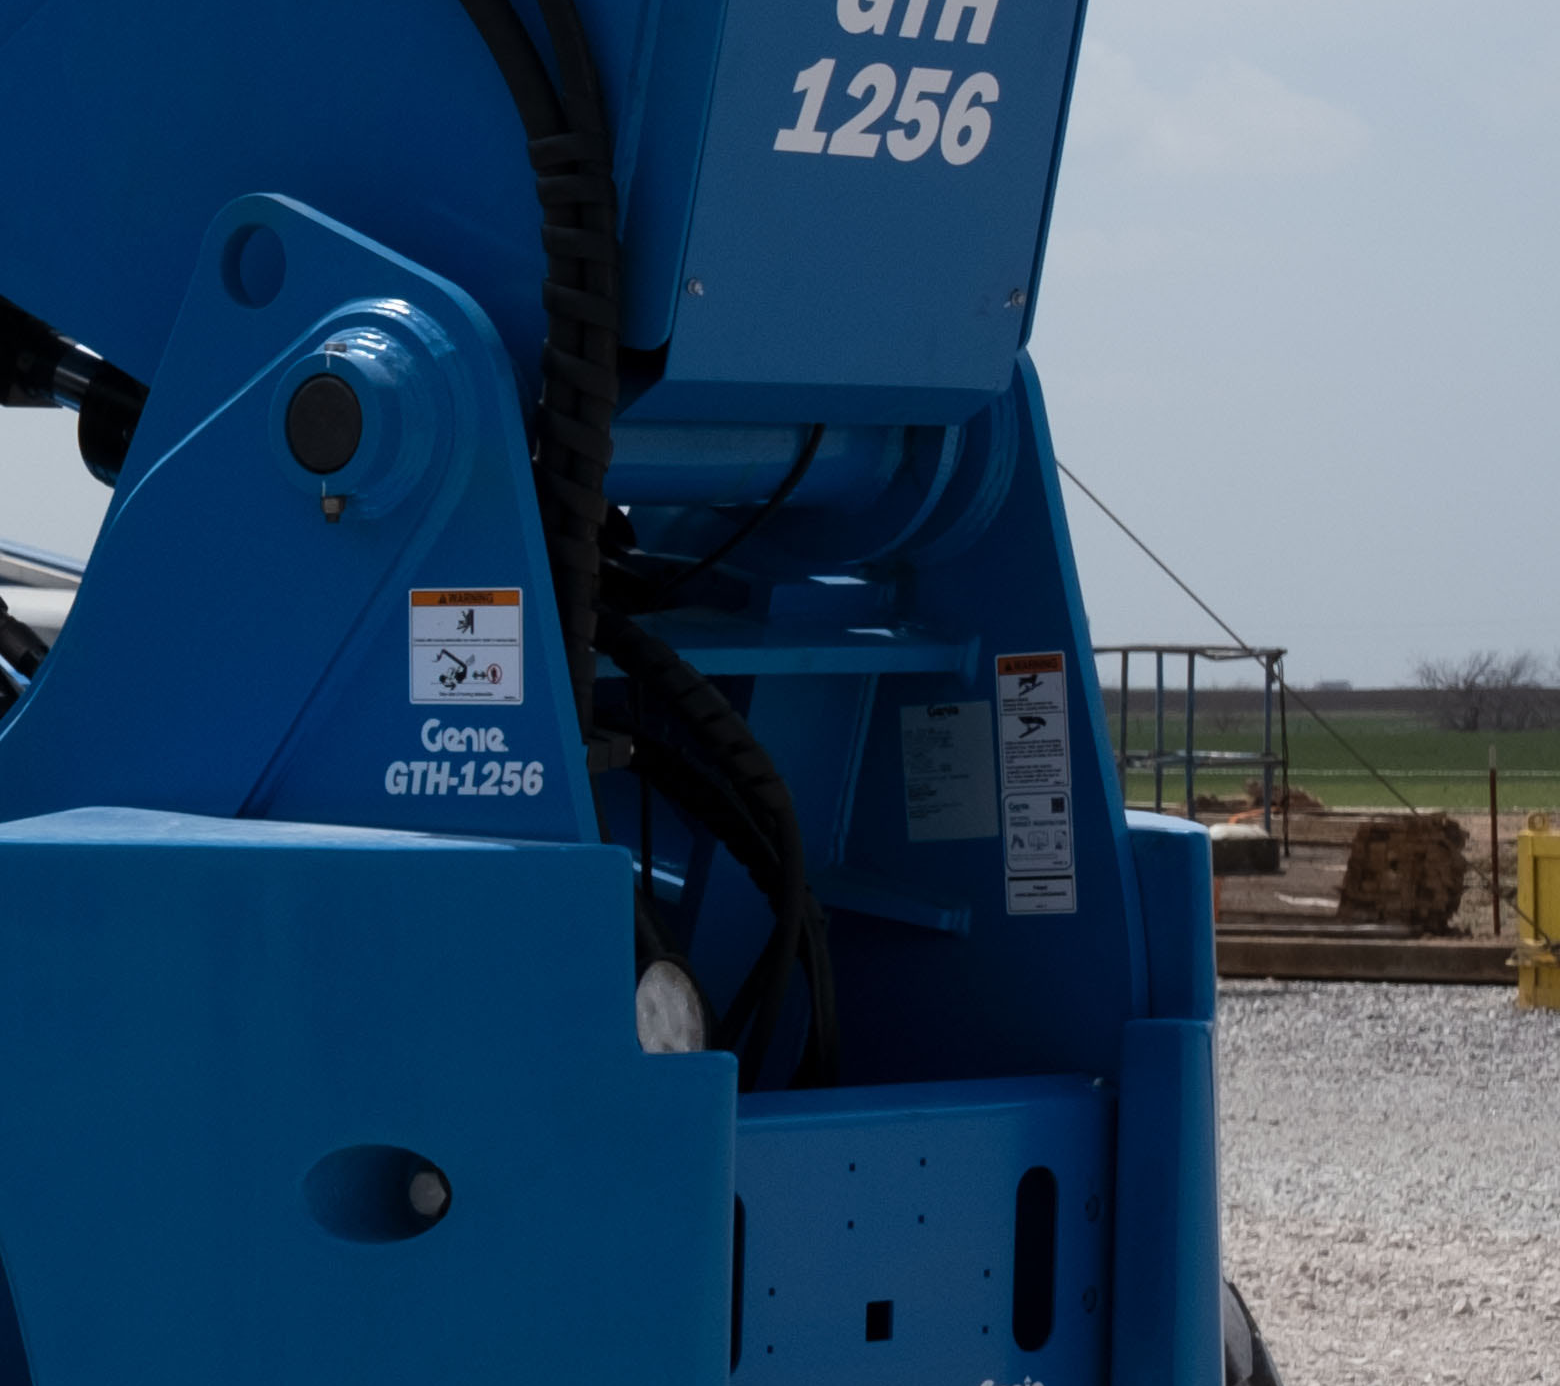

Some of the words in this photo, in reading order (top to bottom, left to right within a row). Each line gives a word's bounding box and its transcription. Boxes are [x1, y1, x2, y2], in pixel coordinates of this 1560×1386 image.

[772, 58, 1000, 166] 1256
[421, 718, 505, 752] Genie
[384, 760, 544, 796] GTH-1256
